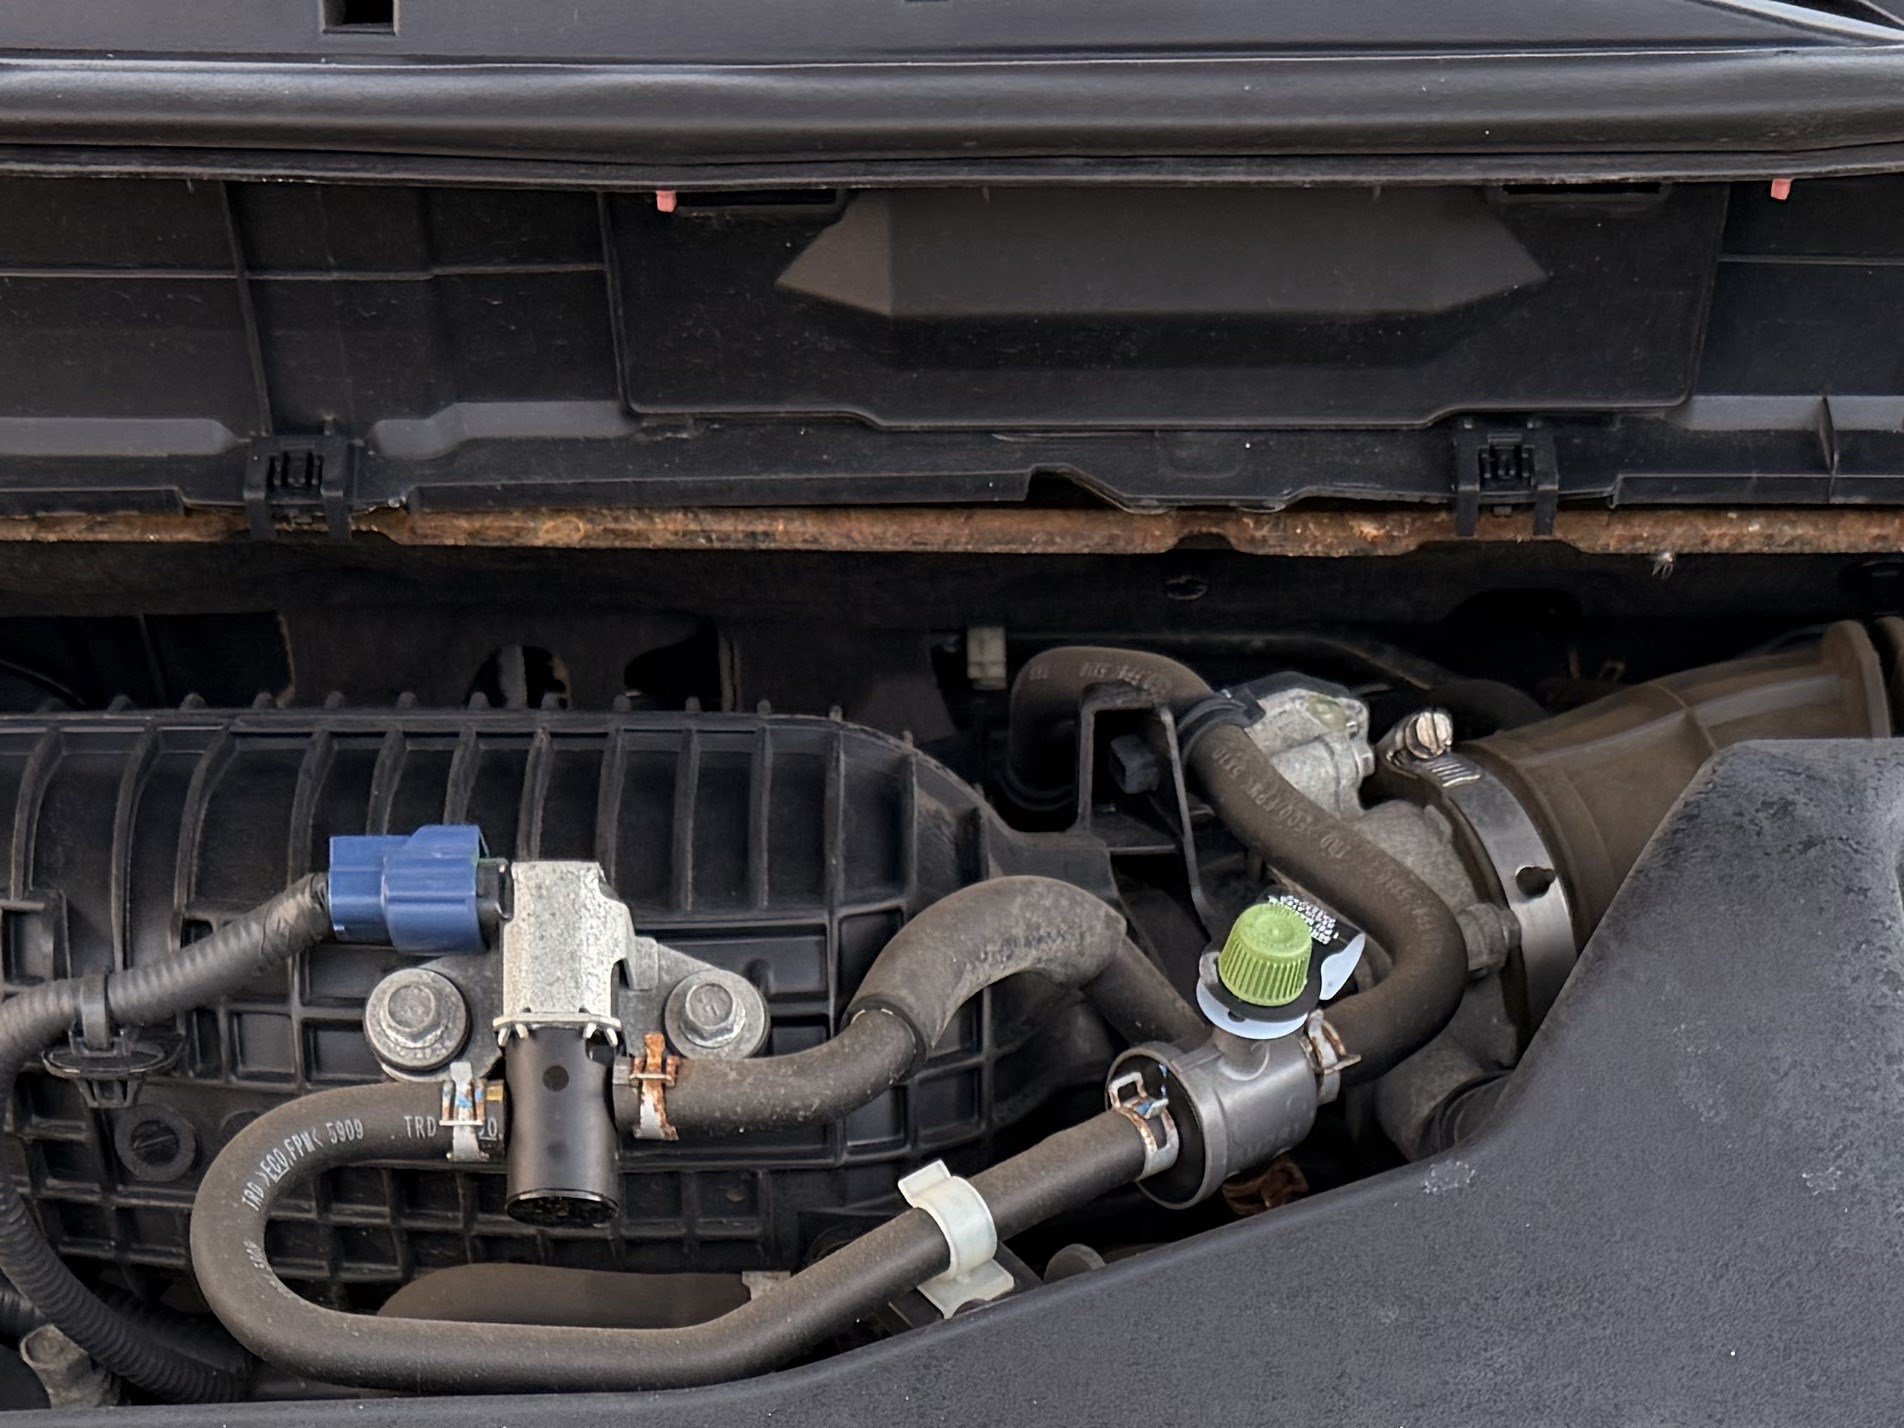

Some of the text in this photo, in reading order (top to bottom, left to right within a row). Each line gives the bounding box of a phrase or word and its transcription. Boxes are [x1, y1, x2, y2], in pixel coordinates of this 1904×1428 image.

[403, 1114, 437, 1139] TRD
[241, 1180, 266, 1212] TRD
[325, 1117, 365, 1145] 5909
